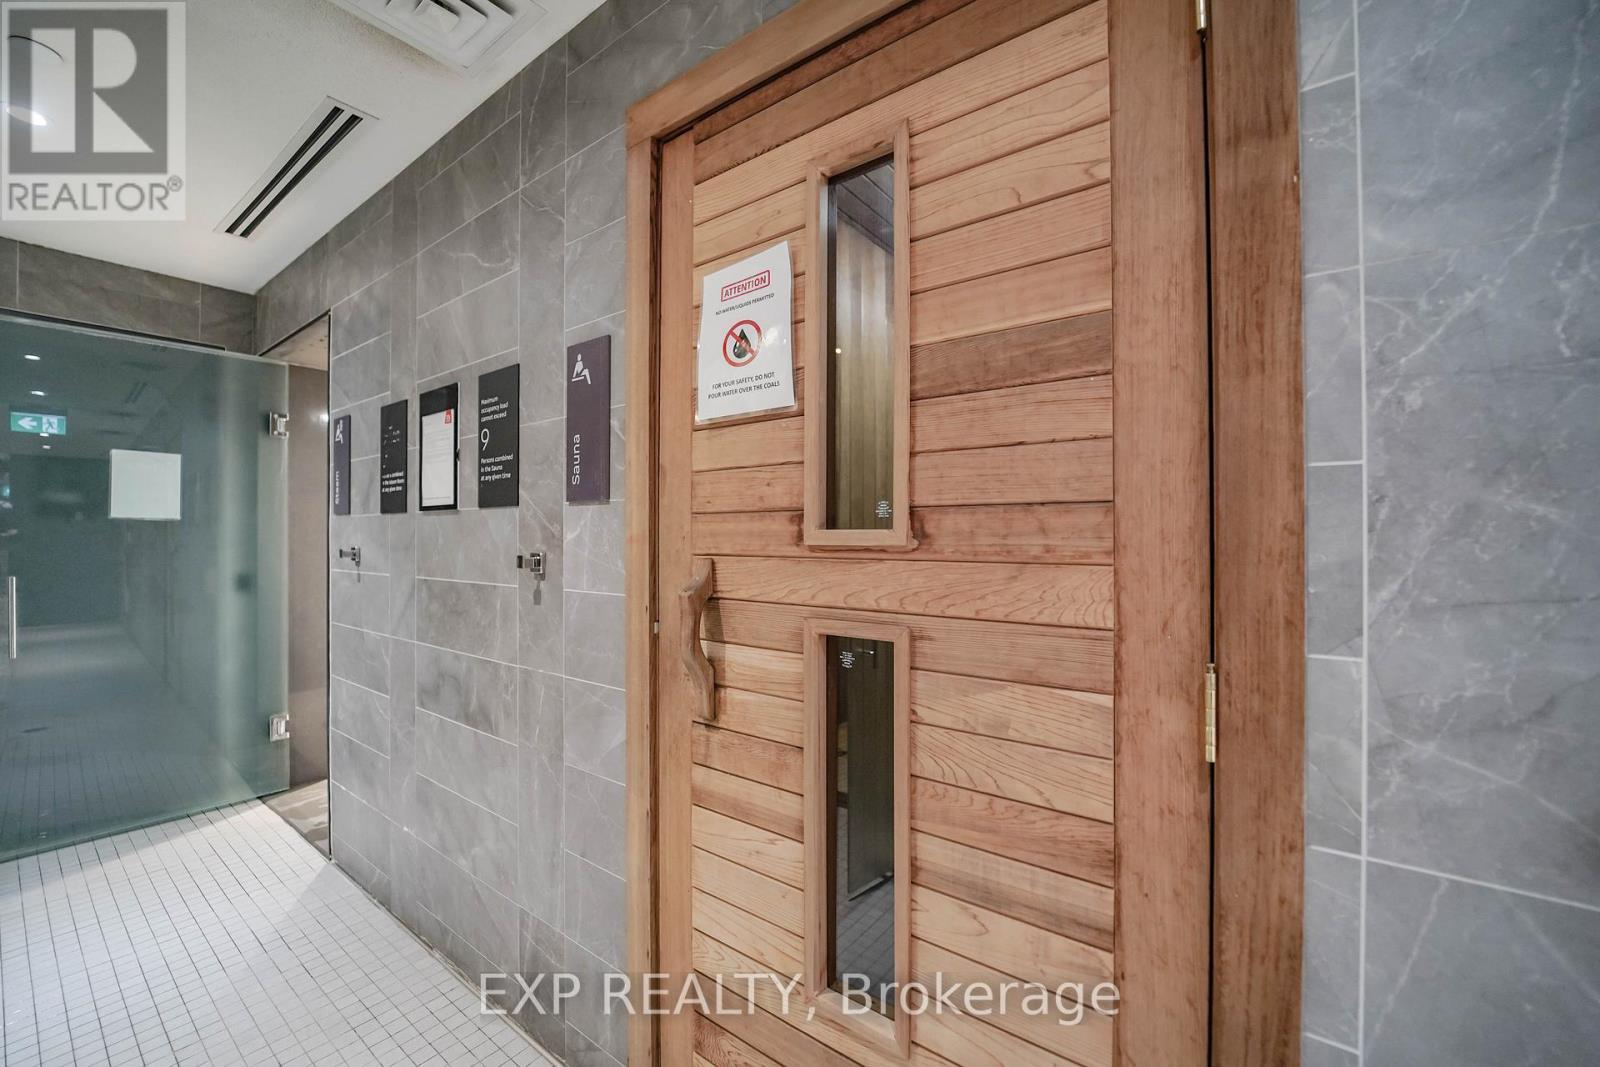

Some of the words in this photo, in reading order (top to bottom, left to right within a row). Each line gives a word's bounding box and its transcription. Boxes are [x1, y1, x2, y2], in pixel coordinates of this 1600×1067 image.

[724, 275, 766, 298] ATTENTION
[752, 293, 774, 304] PERMITTED
[764, 380, 780, 389] COALS
[480, 405, 499, 413] occupancy
[494, 409, 506, 419] exceed
[481, 428, 489, 451] 9
[495, 453, 513, 462] combined
[572, 434, 580, 485] Sauna
